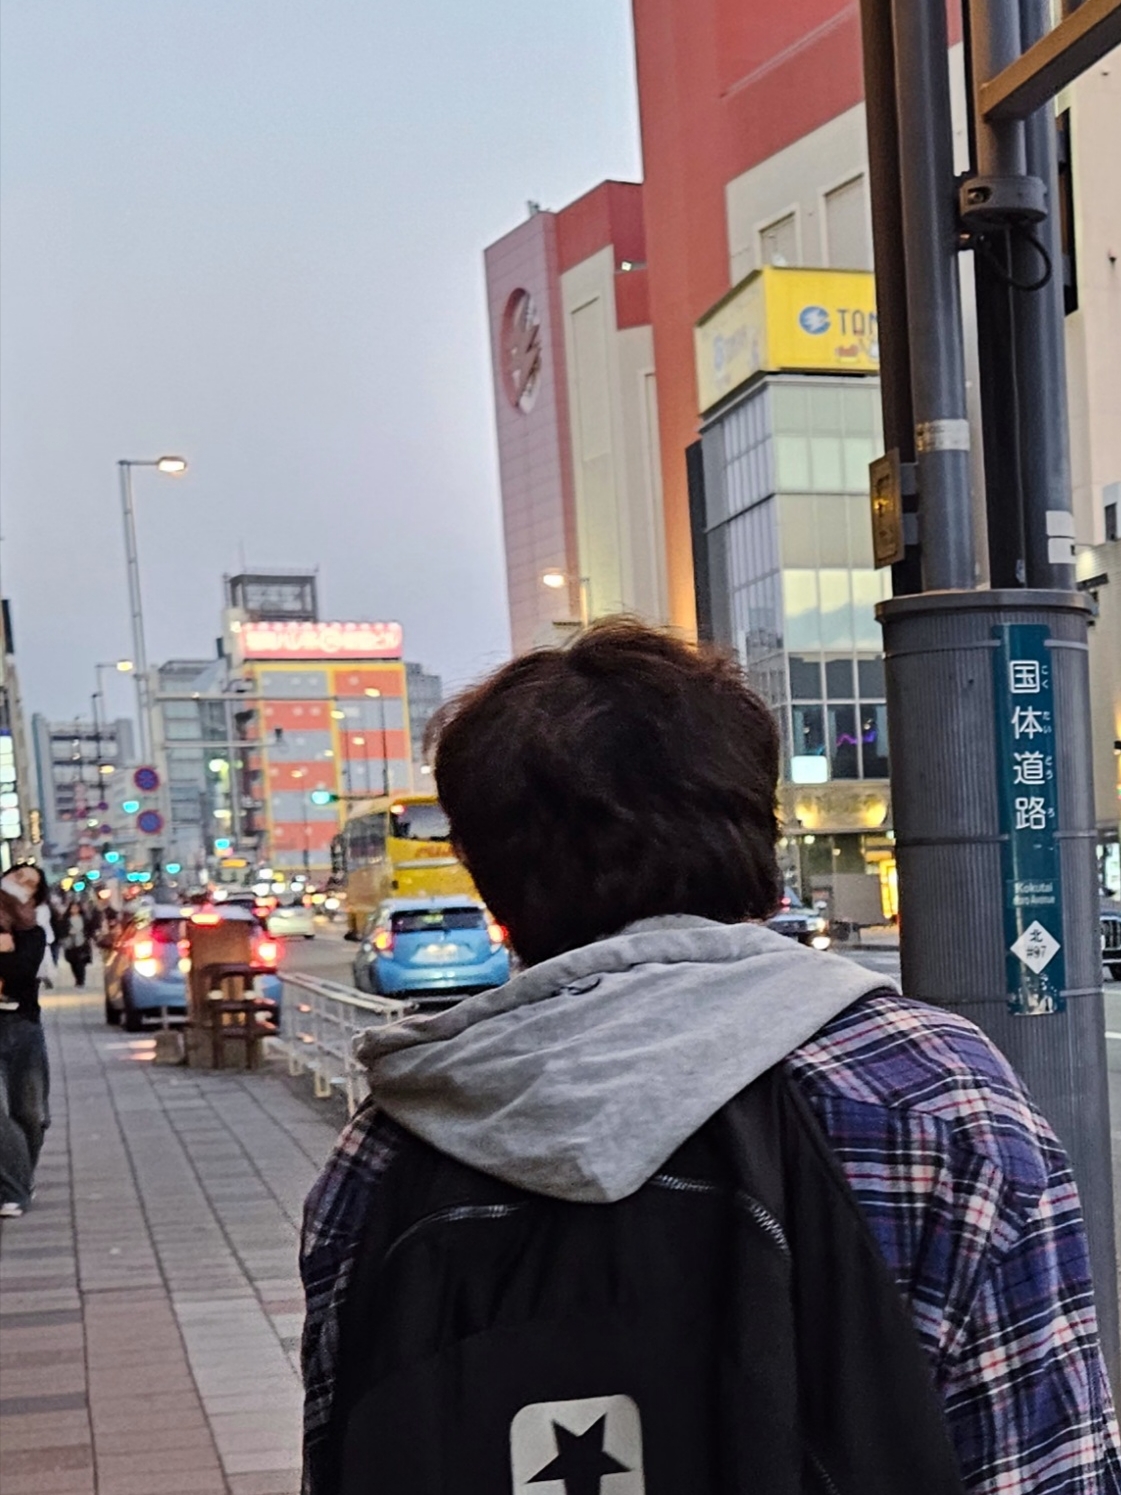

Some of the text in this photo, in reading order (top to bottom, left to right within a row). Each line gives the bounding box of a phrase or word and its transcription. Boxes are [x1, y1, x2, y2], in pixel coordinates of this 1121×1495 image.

[1010, 660, 1047, 830] 国体道路
[1014, 881, 1053, 894] Kokutai
[1029, 928, 1044, 943] 北
